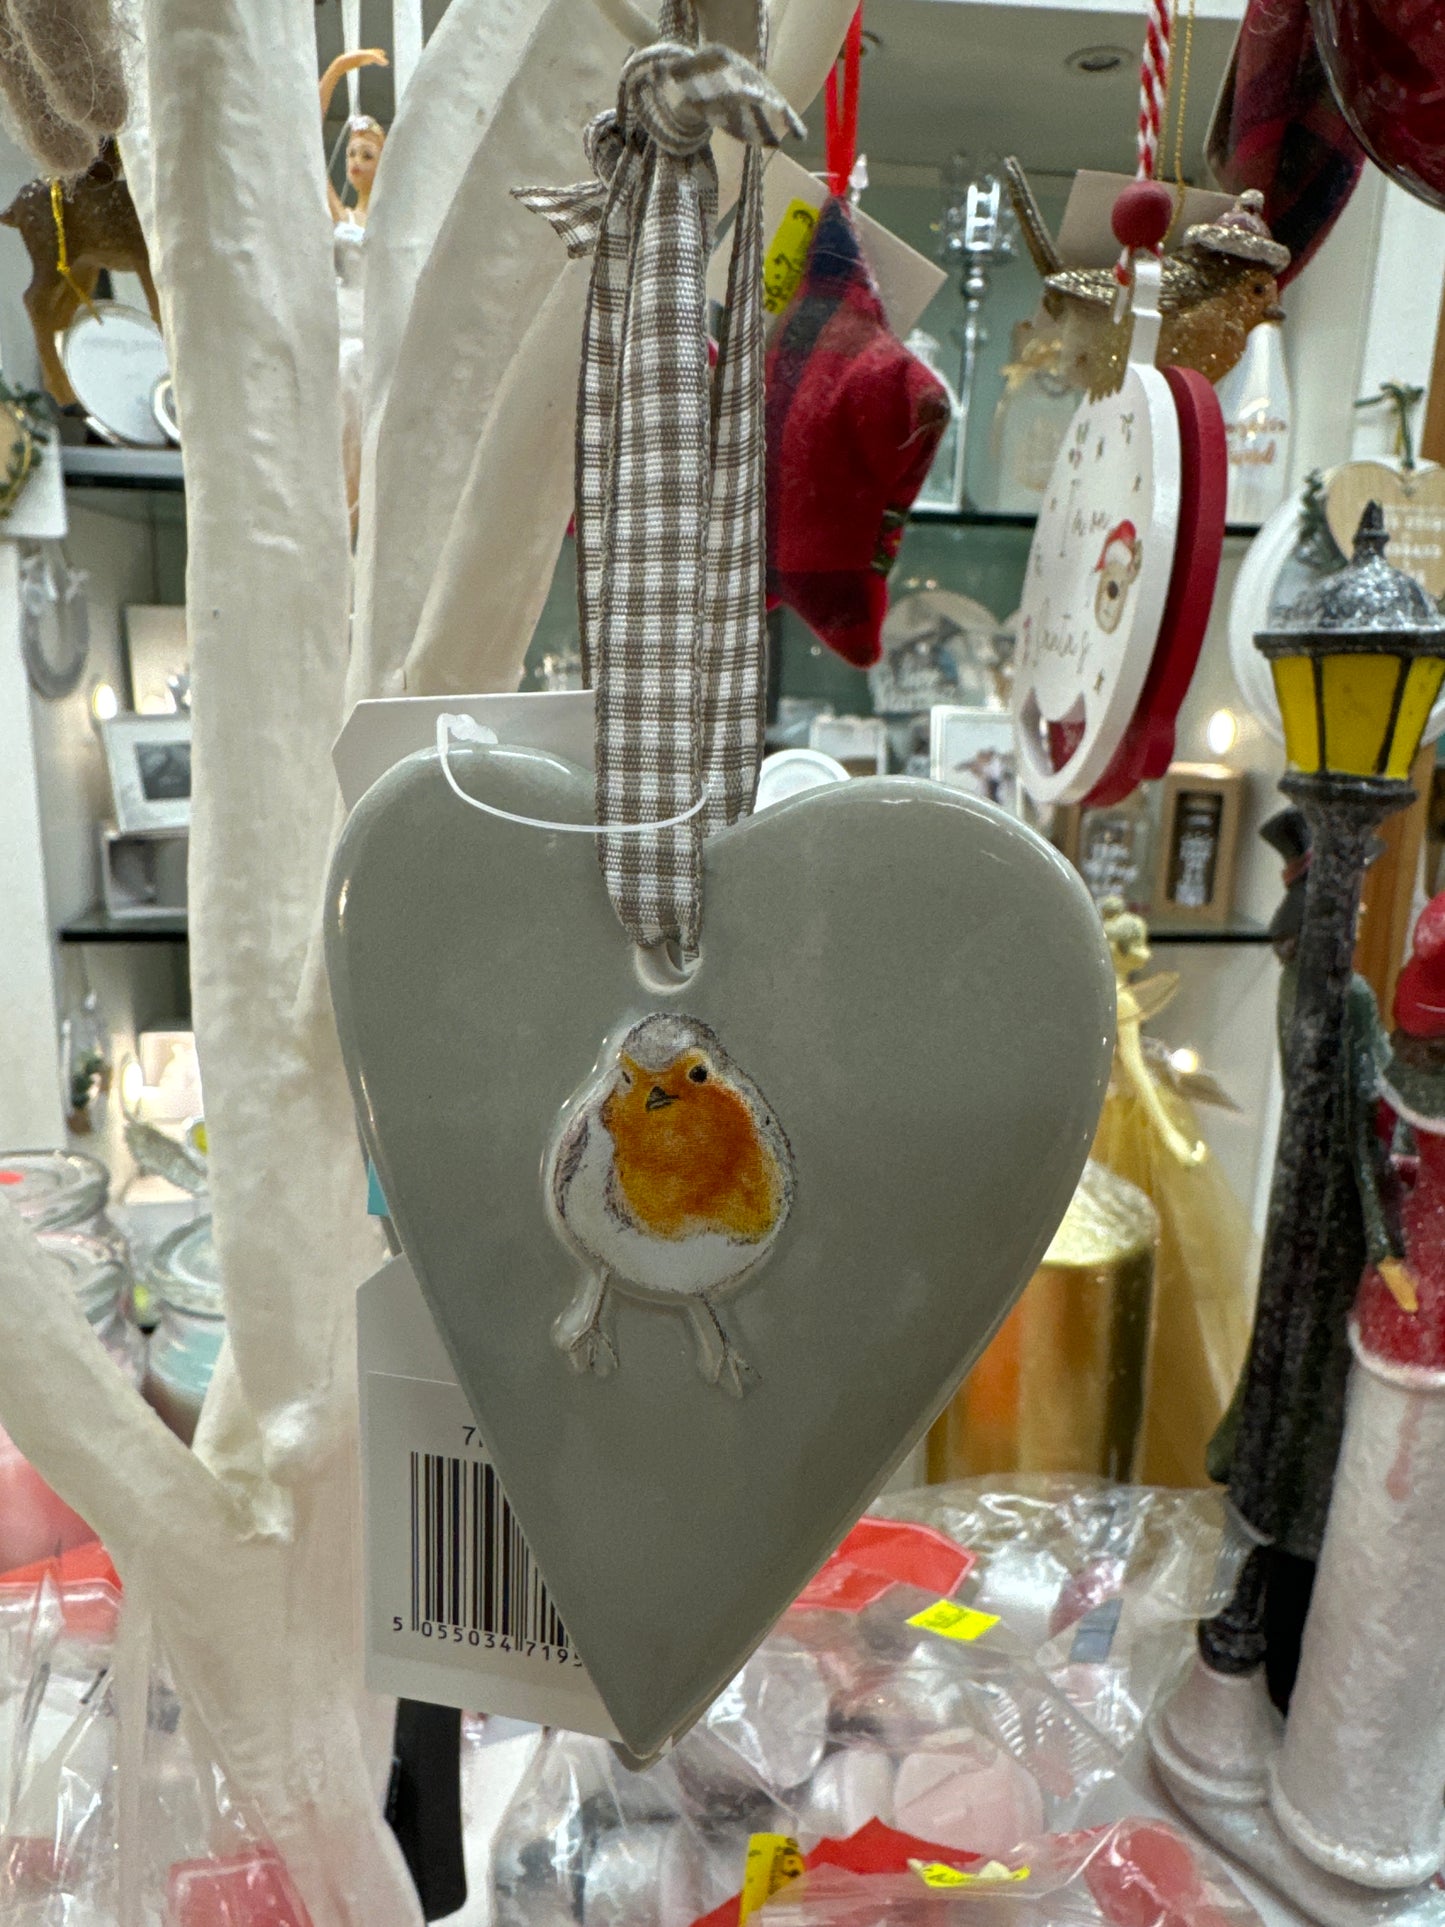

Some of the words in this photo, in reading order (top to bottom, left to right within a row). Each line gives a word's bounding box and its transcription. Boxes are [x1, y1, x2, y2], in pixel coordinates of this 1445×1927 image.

[462, 1425, 484, 1448] 7
[393, 1616, 403, 1632] 5
[421, 1621, 512, 1652] 055034
